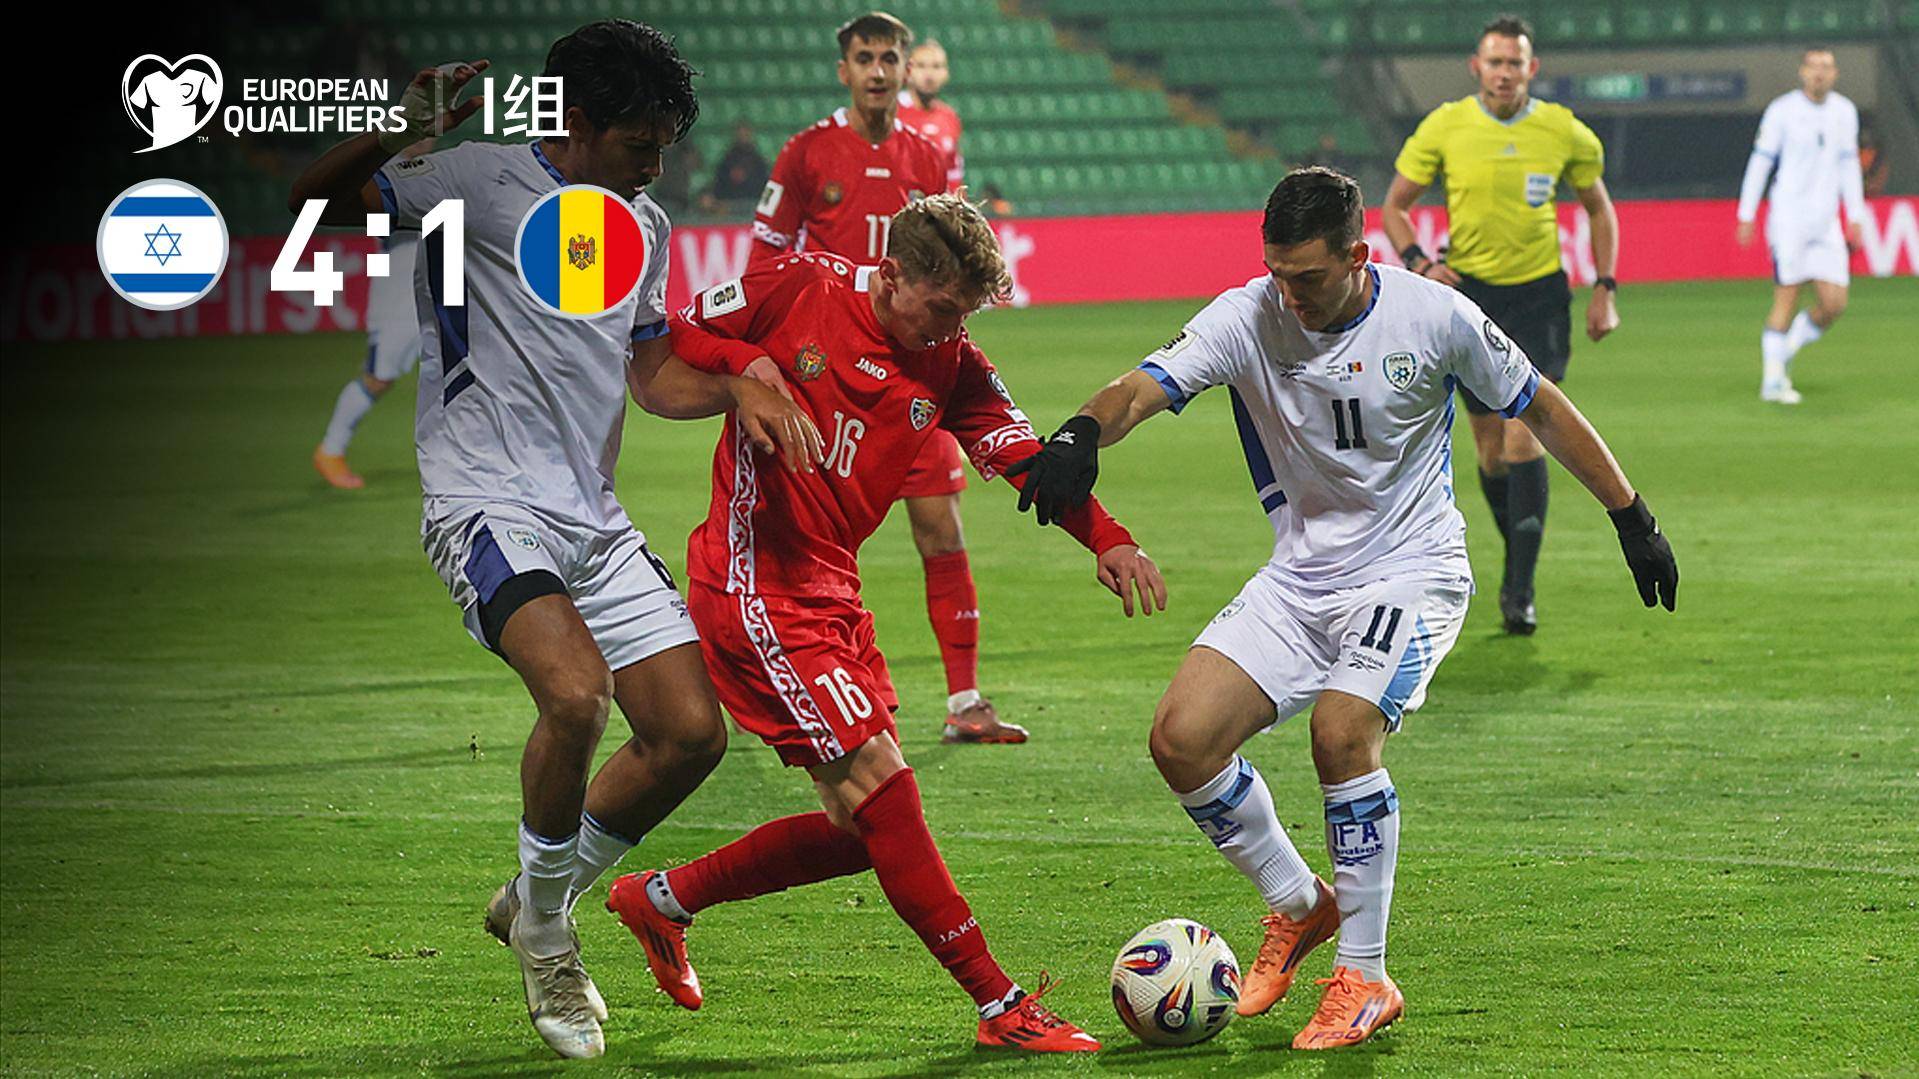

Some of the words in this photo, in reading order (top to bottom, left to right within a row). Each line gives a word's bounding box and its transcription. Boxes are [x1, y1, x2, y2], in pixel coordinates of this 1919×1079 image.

[865, 213, 890, 257] 11
[854, 357, 888, 381] JAKO
[823, 410, 866, 479] 16
[1331, 398, 1368, 450] 11
[1360, 605, 1403, 654] 11
[814, 666, 873, 727] 16
[939, 916, 977, 945] JAKO
